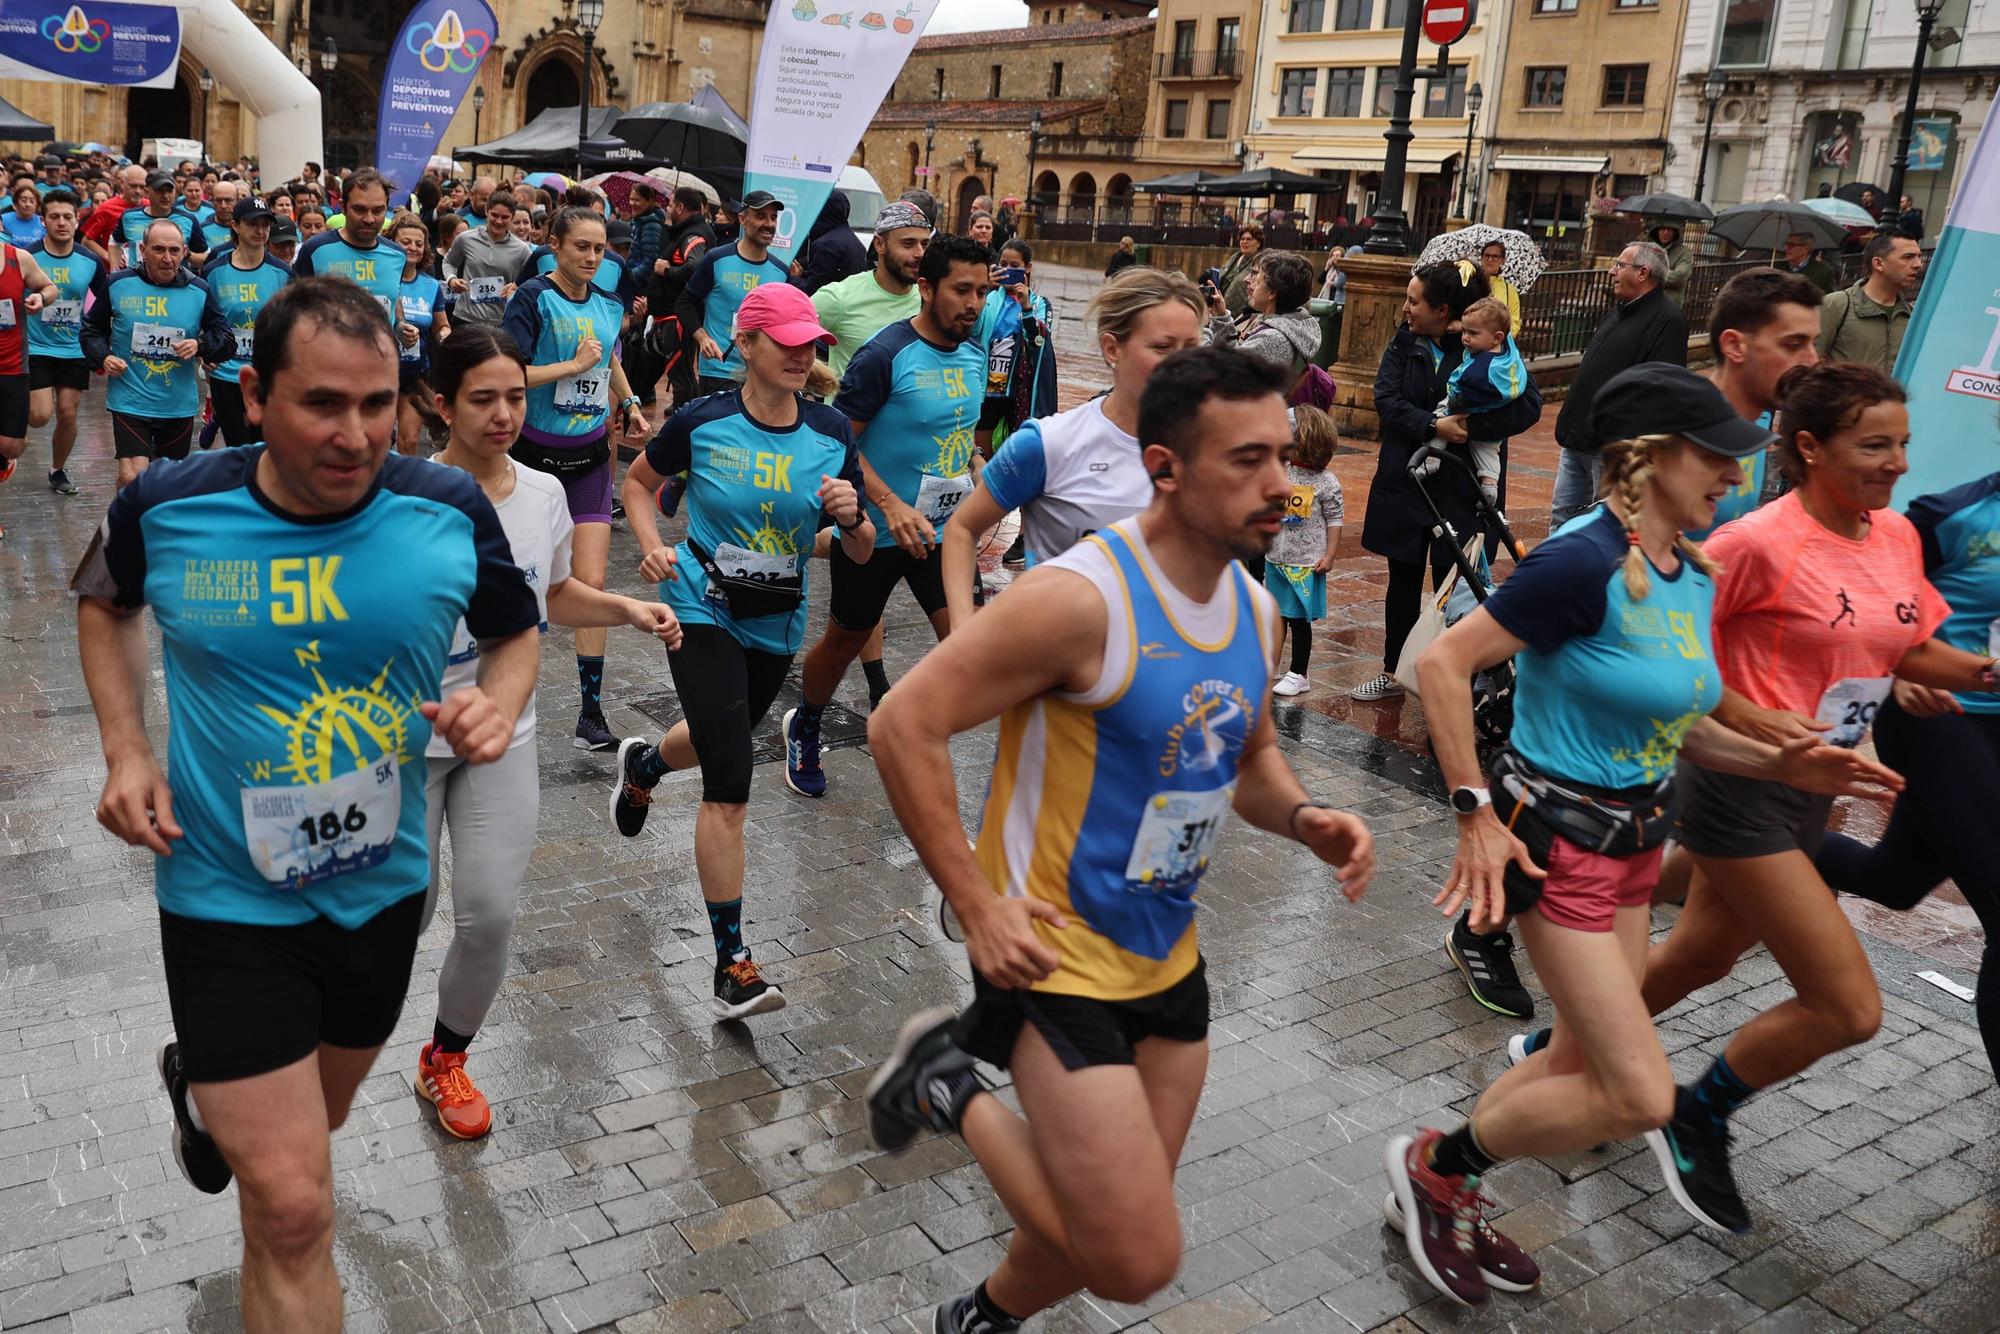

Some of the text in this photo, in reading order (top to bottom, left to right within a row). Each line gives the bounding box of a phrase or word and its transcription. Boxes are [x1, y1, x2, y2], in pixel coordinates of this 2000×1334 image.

[113, 32, 171, 43] PREVENTIVOS
[781, 44, 796, 53] Evita
[805, 47, 840, 58] sobrepeso
[779, 64, 854, 81] Sigue una alimentación
[393, 85, 451, 98] DEPORTIVOS
[776, 85, 811, 97] equilibrada
[391, 101, 454, 115] PREVENTIVOS
[774, 104, 806, 117] adecuada
[807, 108, 814, 117] de
[775, 95, 840, 110] Asegura una ingesta
[53, 267, 71, 284] 5K
[355, 259, 377, 281] 5K
[478, 285, 496, 293] 236
[743, 272, 760, 291] 5K
[239, 283, 259, 303] 5K
[55, 308, 72, 317] 317
[145, 296, 169, 317] 5K
[148, 335, 171, 348] 241
[575, 379, 600, 396] 157
[943, 367, 971, 399] 5K
[753, 451, 793, 494] 5K
[938, 491, 963, 509] 133
[201, 559, 259, 573] CARRERA
[524, 566, 538, 583] 5K
[216, 572, 239, 586] POR
[242, 572, 259, 586] LA
[183, 586, 260, 601] SEGURIDAD
[270, 555, 350, 626] 5K
[1667, 609, 1708, 660] 5K
[375, 761, 394, 785] 5K
[298, 802, 367, 846] 186
